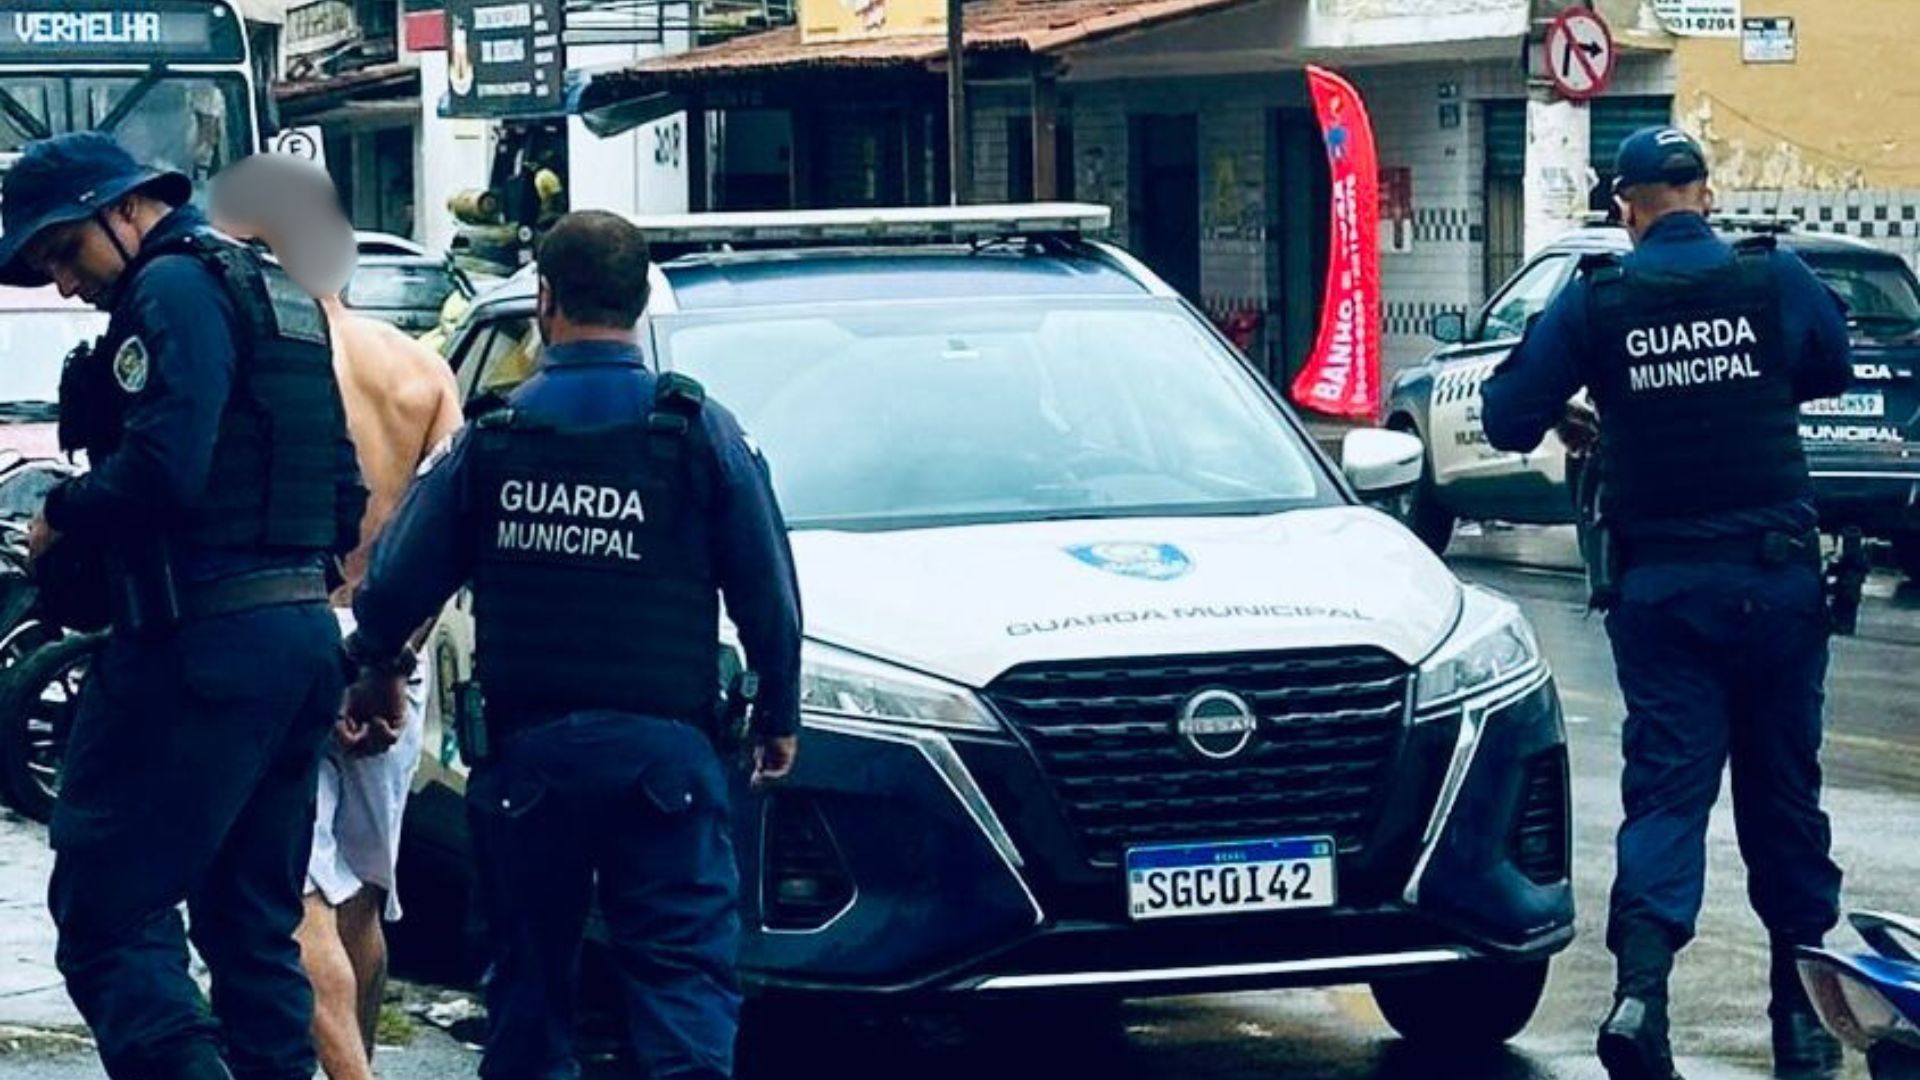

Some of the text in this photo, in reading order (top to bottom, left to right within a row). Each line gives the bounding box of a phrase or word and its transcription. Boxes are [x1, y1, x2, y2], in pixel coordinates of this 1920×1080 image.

[15, 12, 160, 43] VERMELHA
[1309, 299, 1354, 401] BANHO
[1626, 316, 1757, 358] GUARDA
[1629, 353, 1762, 392] MUNICIPAL
[500, 480, 645, 523] GUARDA
[498, 520, 643, 561] MUNICIPAL
[1006, 604, 1374, 637] GUARDA MUNICIPAL
